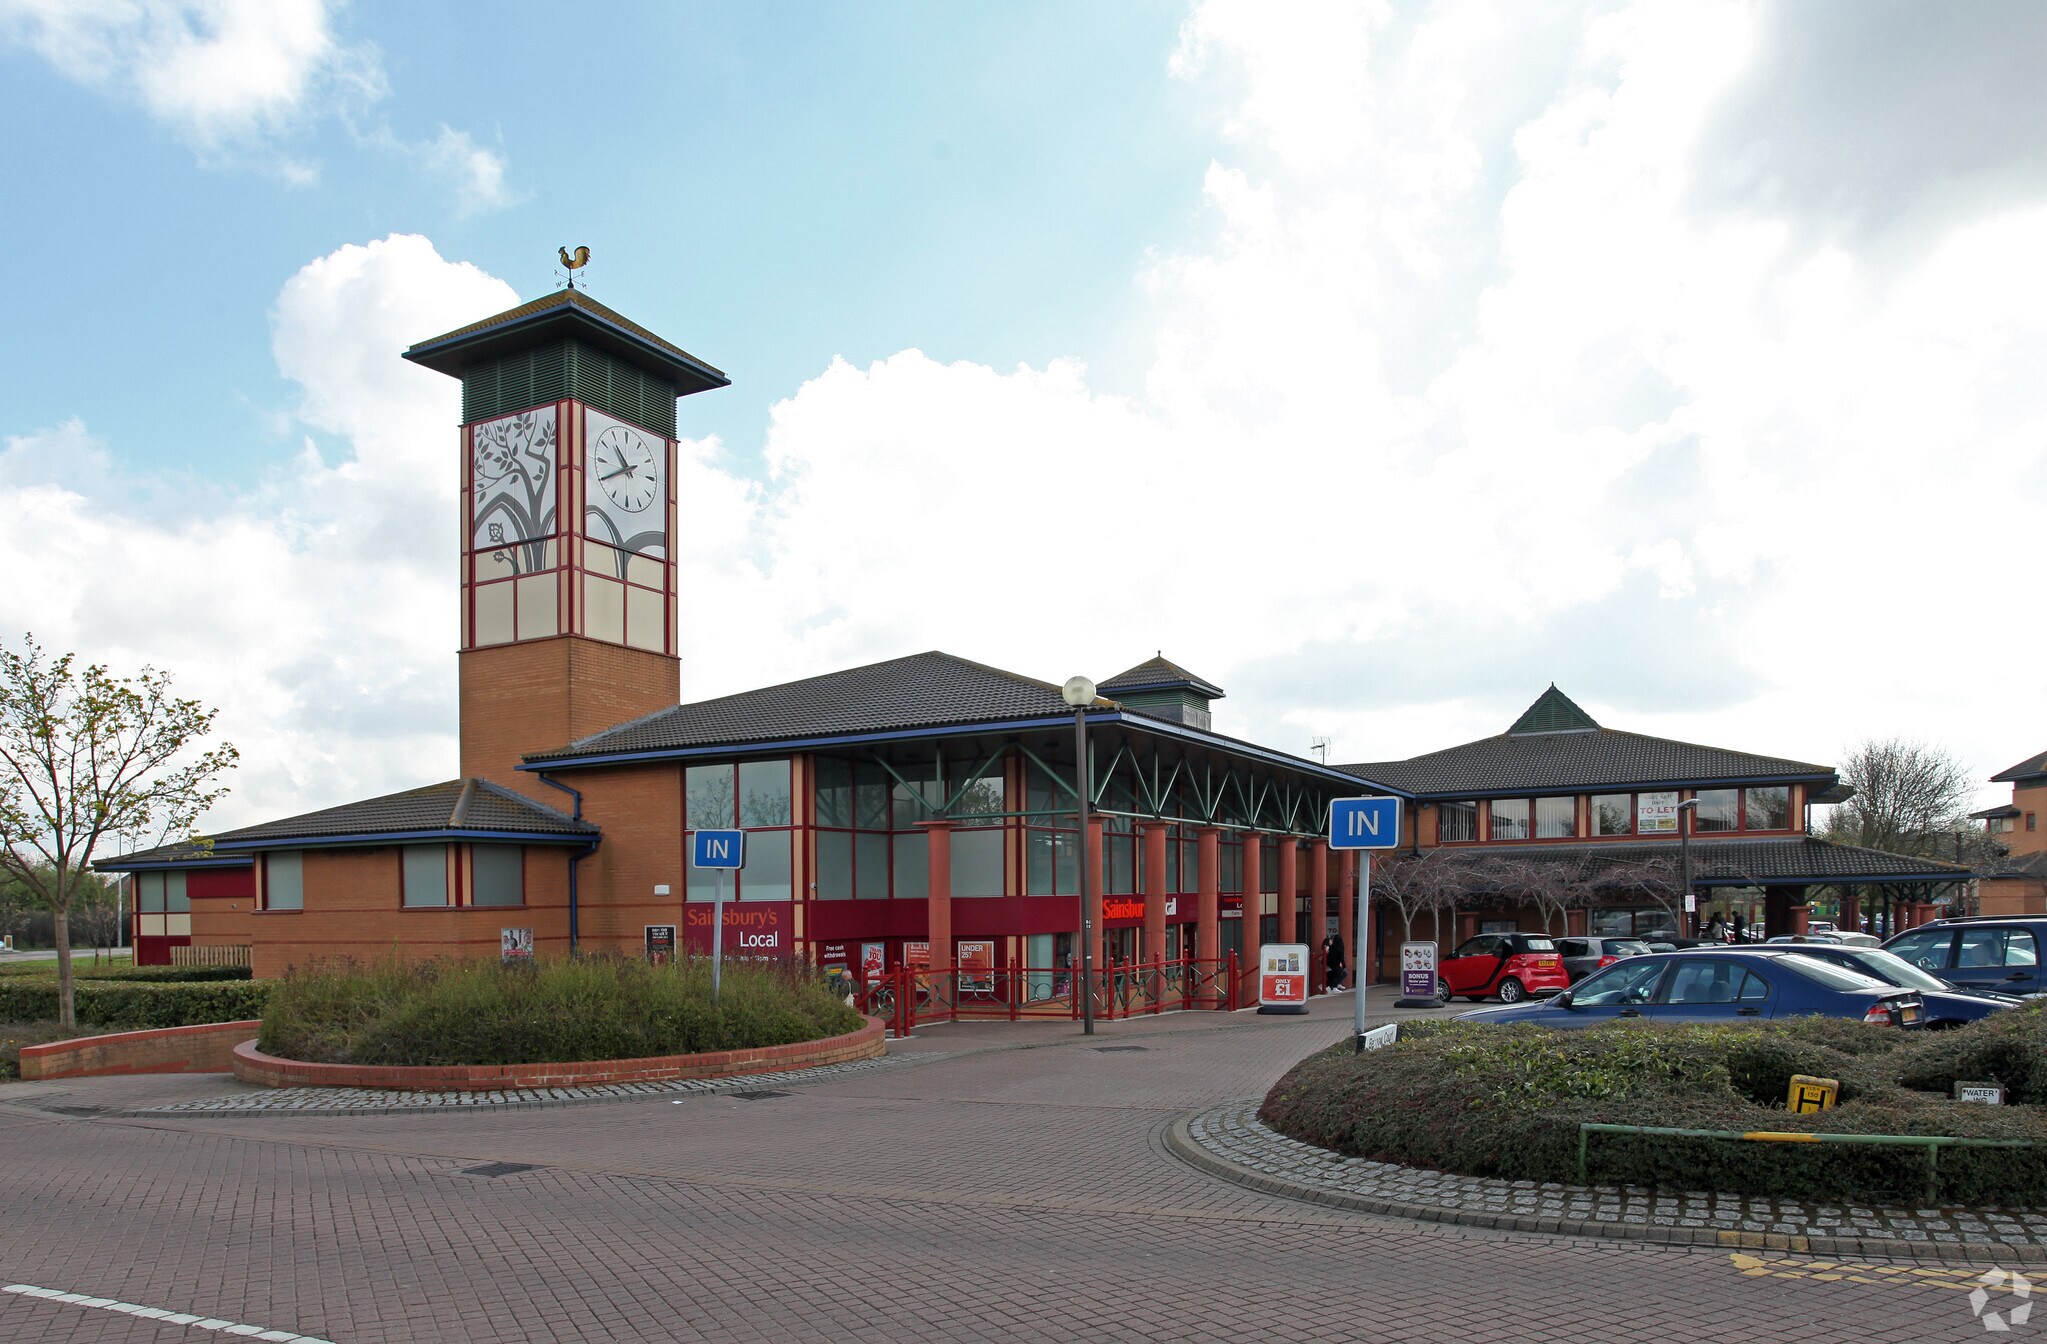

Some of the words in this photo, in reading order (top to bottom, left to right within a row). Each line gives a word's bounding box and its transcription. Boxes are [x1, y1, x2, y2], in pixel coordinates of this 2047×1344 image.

[1348, 810, 1378, 836] IN
[706, 840, 728, 858] IN
[688, 908, 778, 928] Saisbury's
[740, 931, 778, 947] Local
[869, 952, 882, 960] YOU
[1275, 984, 1290, 996] £1
